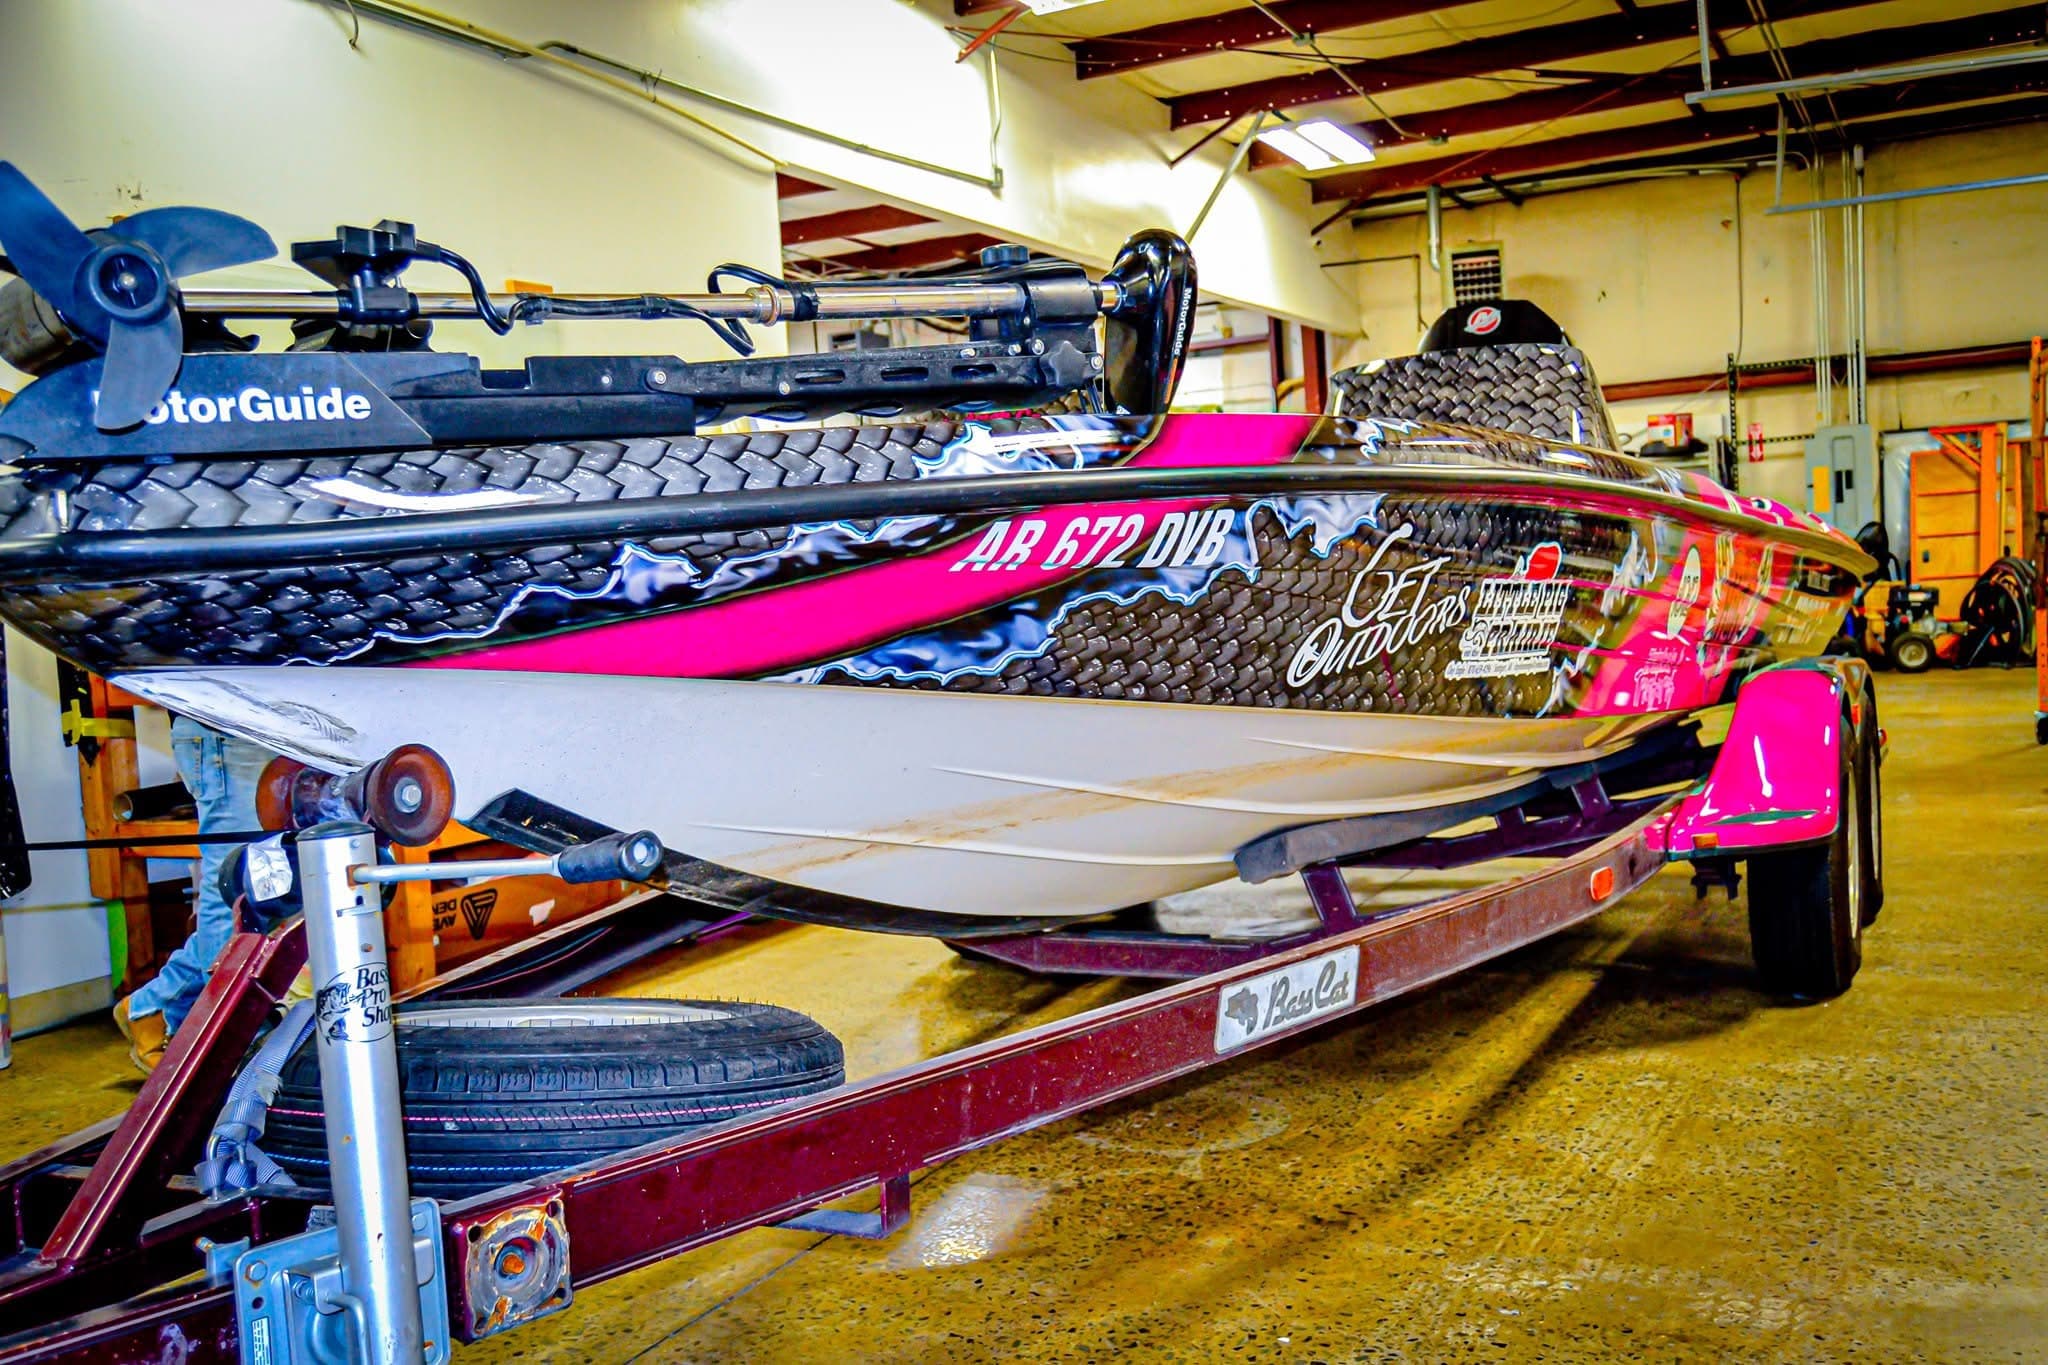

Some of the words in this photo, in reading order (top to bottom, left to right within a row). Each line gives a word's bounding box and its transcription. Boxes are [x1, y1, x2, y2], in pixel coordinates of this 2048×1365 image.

[1174, 286, 1193, 356] MotorGuide
[93, 387, 373, 425] otorGuide
[949, 519, 1047, 572] AR
[1040, 513, 1145, 570] 672
[1136, 508, 1235, 569] DVB
[358, 988, 387, 1008] Pro
